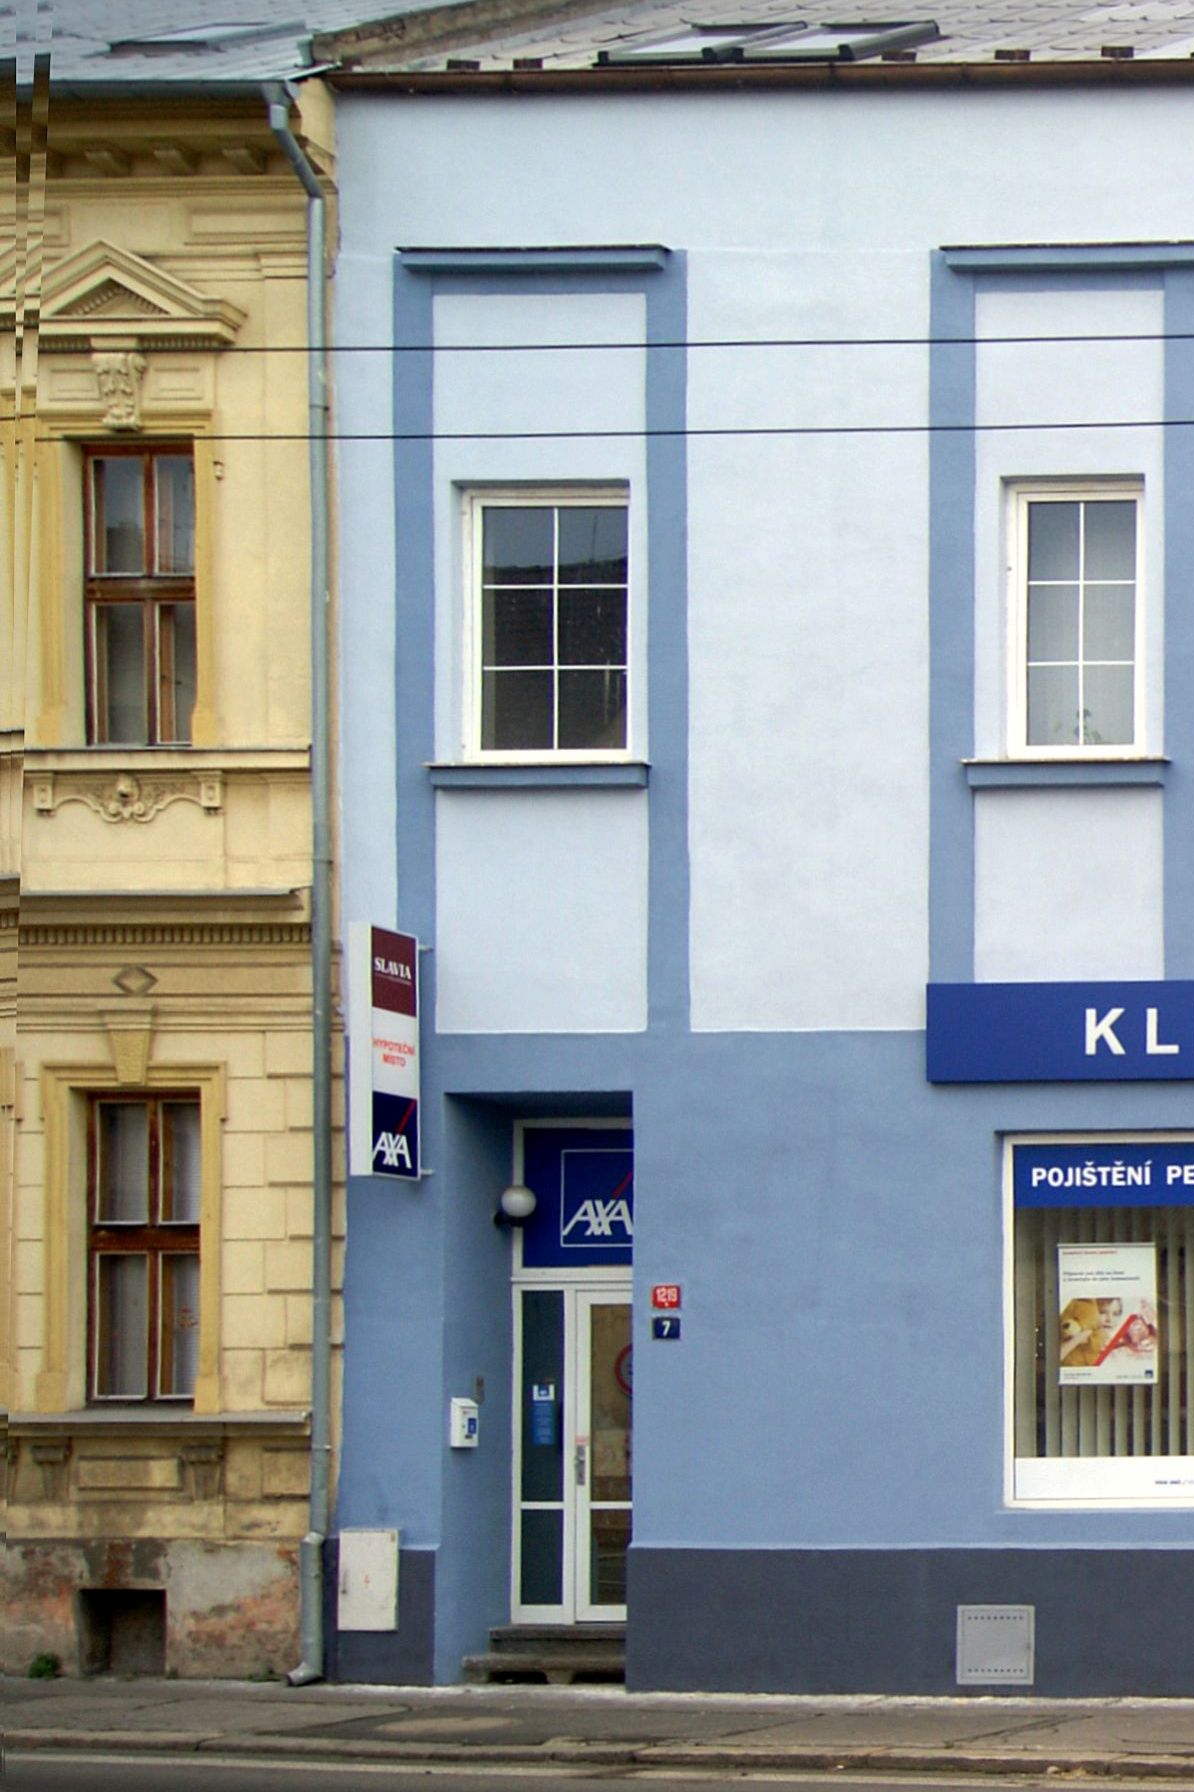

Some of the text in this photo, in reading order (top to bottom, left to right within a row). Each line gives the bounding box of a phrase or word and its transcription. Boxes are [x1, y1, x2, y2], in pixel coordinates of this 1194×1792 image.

[374, 956, 412, 980] SLAVIA
[372, 1131, 412, 1169] AXA
[1031, 1160, 1153, 1187] POJIŠTĚNÍ
[562, 1199, 633, 1236] AXA
[662, 1320, 671, 1337] 7
